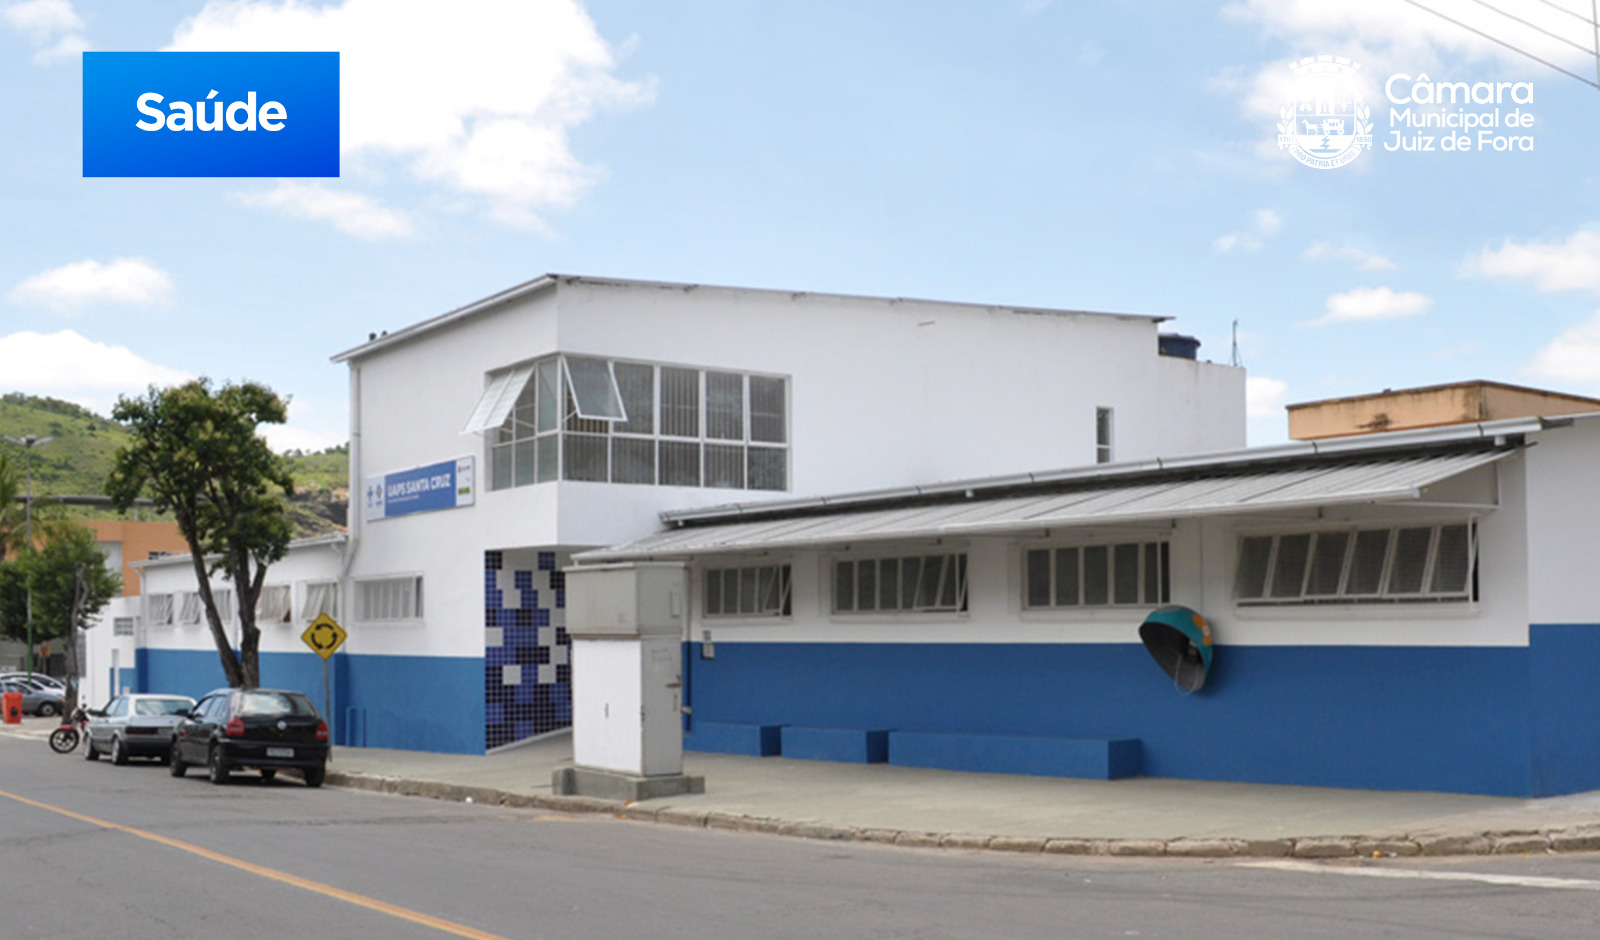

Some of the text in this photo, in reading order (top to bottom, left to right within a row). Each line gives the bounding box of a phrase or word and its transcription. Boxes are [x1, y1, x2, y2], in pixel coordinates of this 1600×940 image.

[388, 473, 451, 497] UAPS SANTA CRUZ
